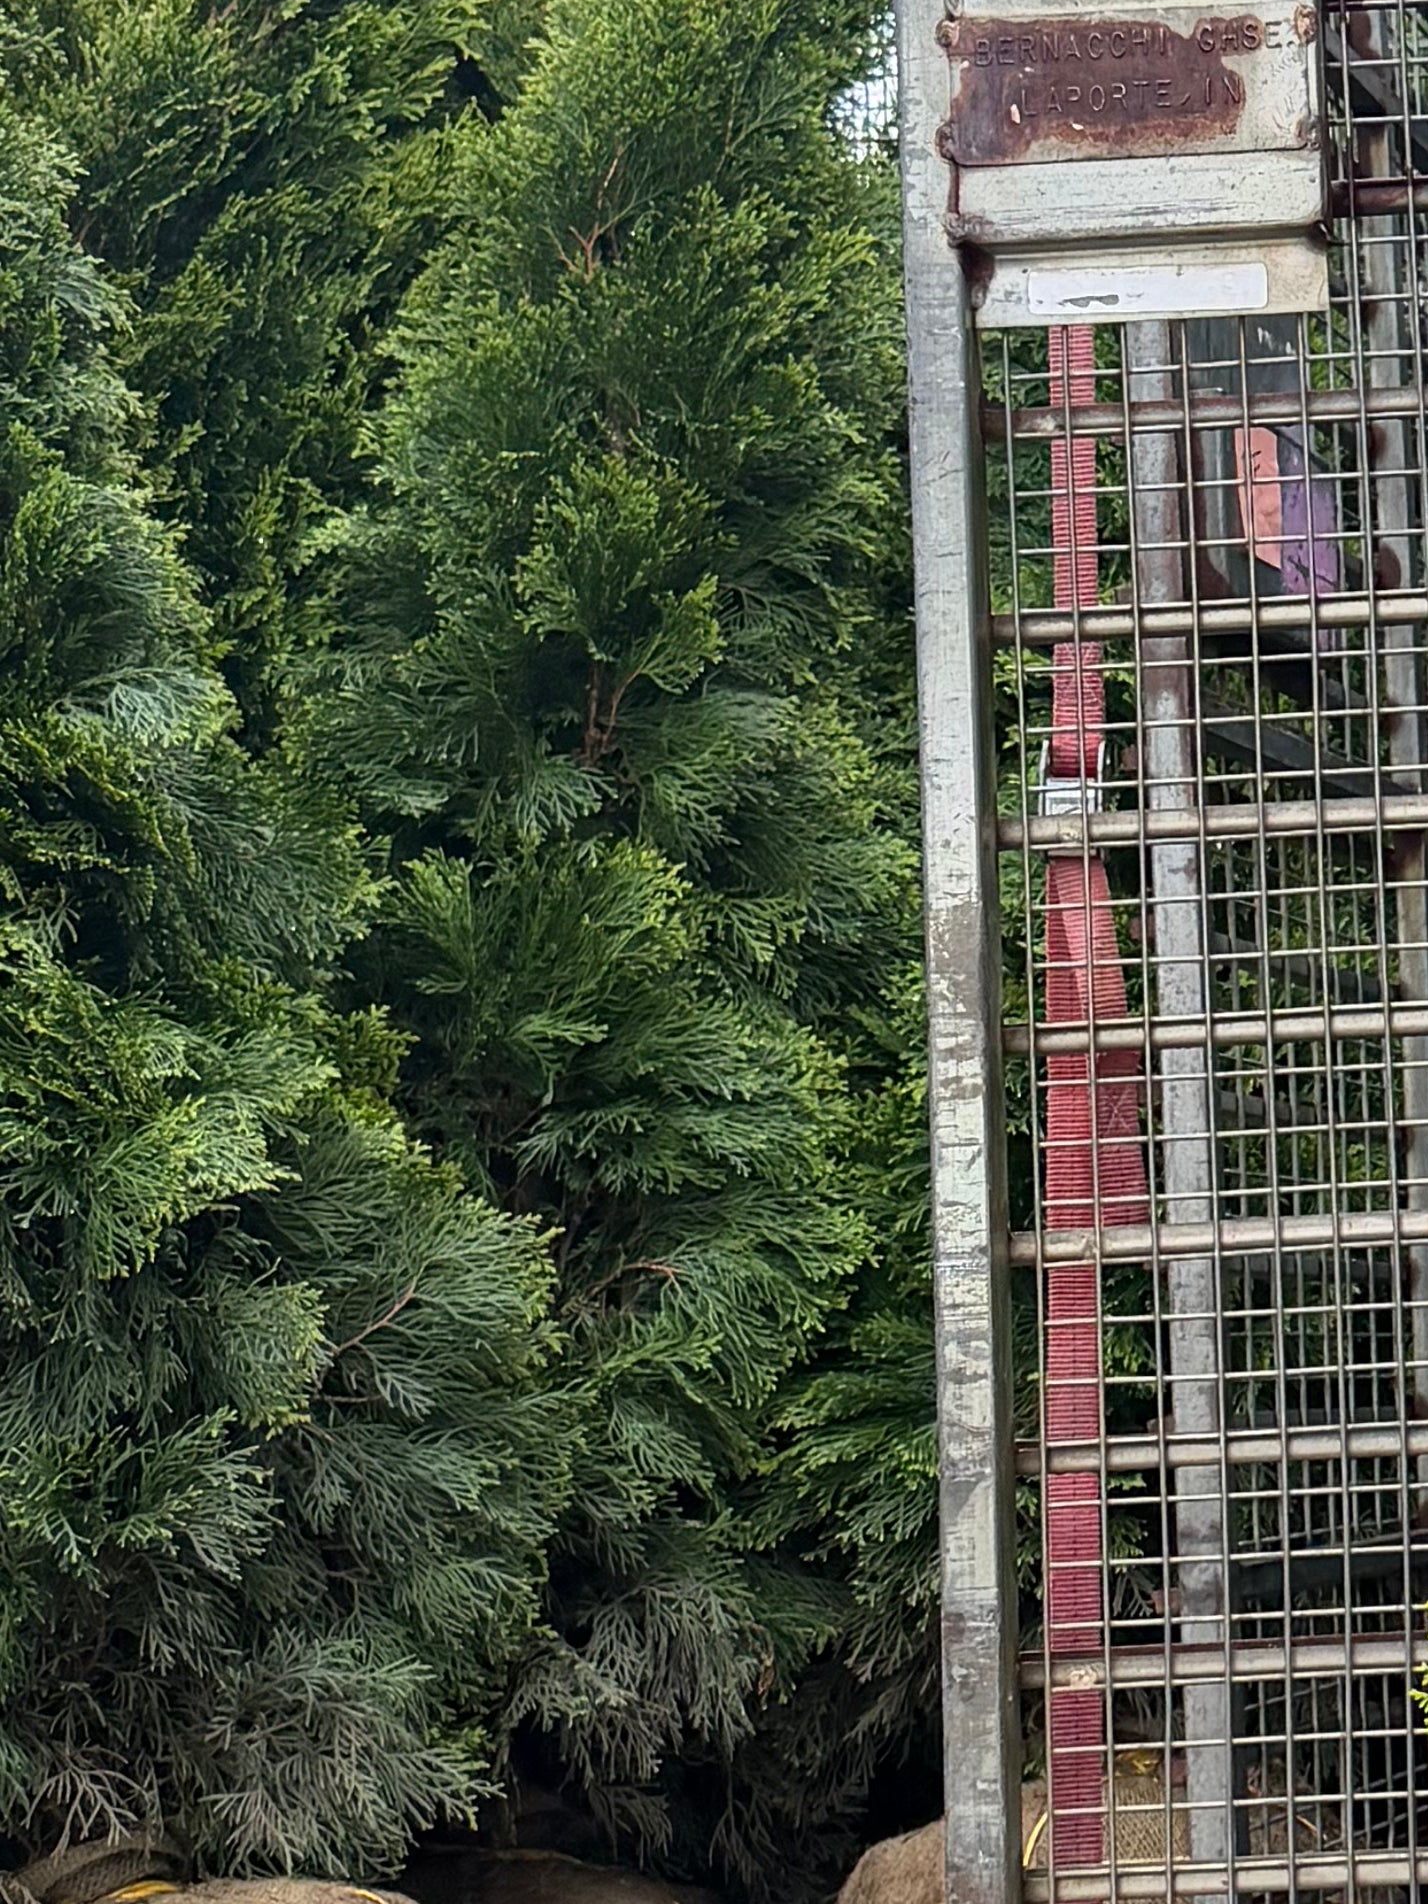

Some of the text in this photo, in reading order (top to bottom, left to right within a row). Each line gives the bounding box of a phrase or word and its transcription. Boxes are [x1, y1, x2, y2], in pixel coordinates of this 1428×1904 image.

[974, 27, 1169, 67] BERNACCHI
[1020, 75, 1241, 116] LAPORTE, IN
